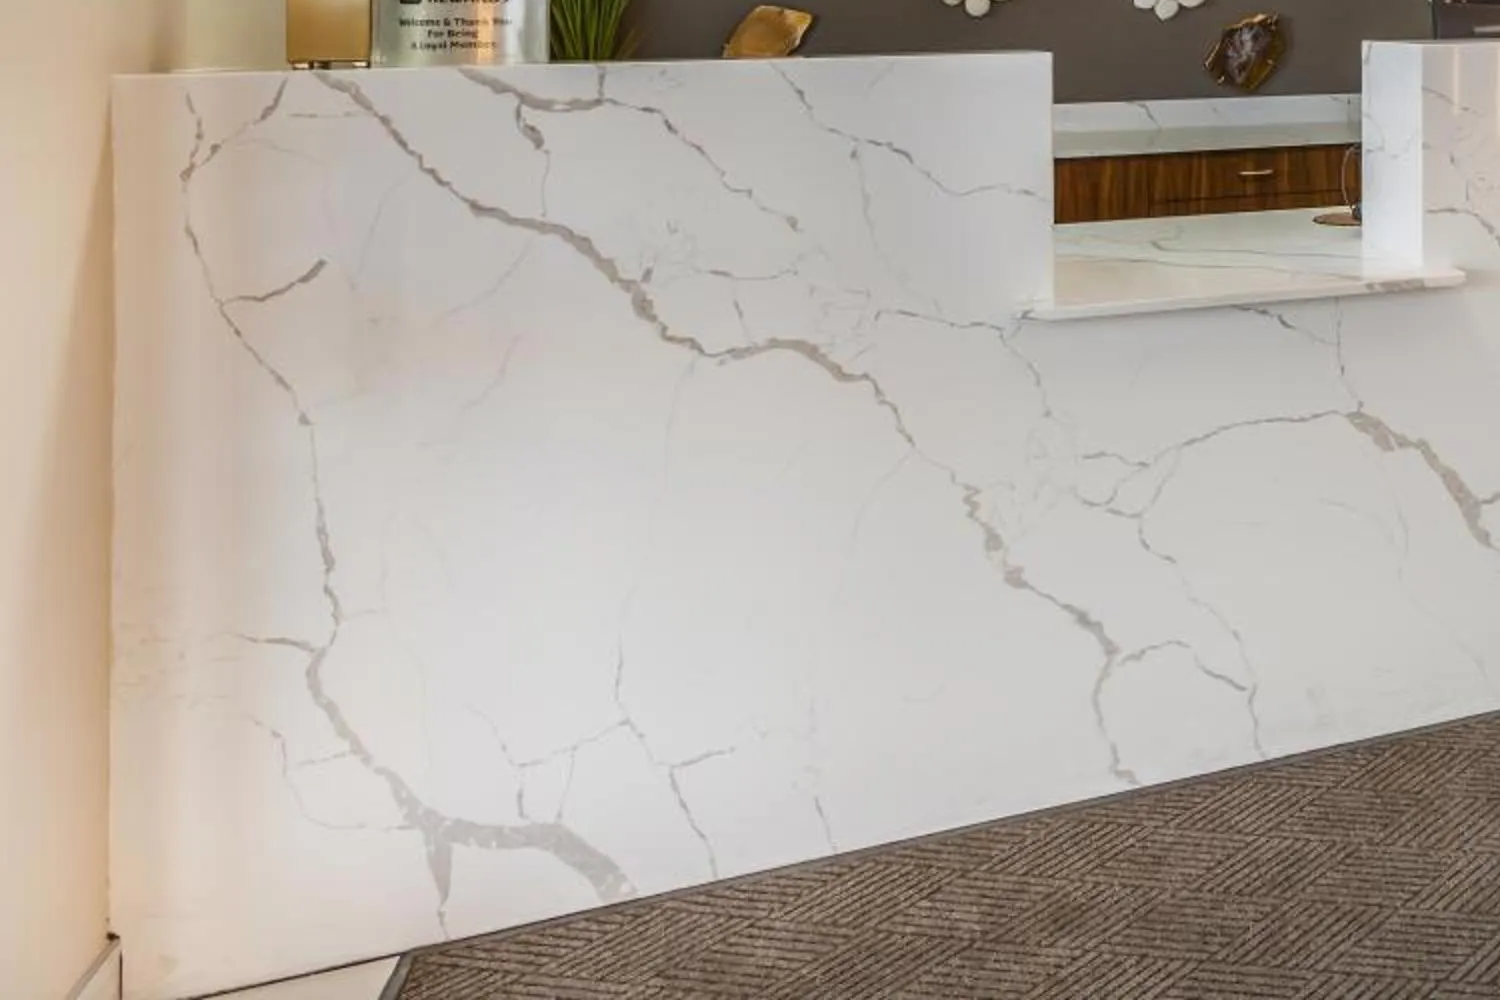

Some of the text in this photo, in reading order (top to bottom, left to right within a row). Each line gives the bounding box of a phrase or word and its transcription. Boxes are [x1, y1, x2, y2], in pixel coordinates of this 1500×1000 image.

[399, 18, 441, 27] Welcome
[454, 17, 490, 26] Thank
[427, 29, 478, 38] For Being
[420, 41, 447, 51] Loyal
[450, 41, 496, 49] Member
